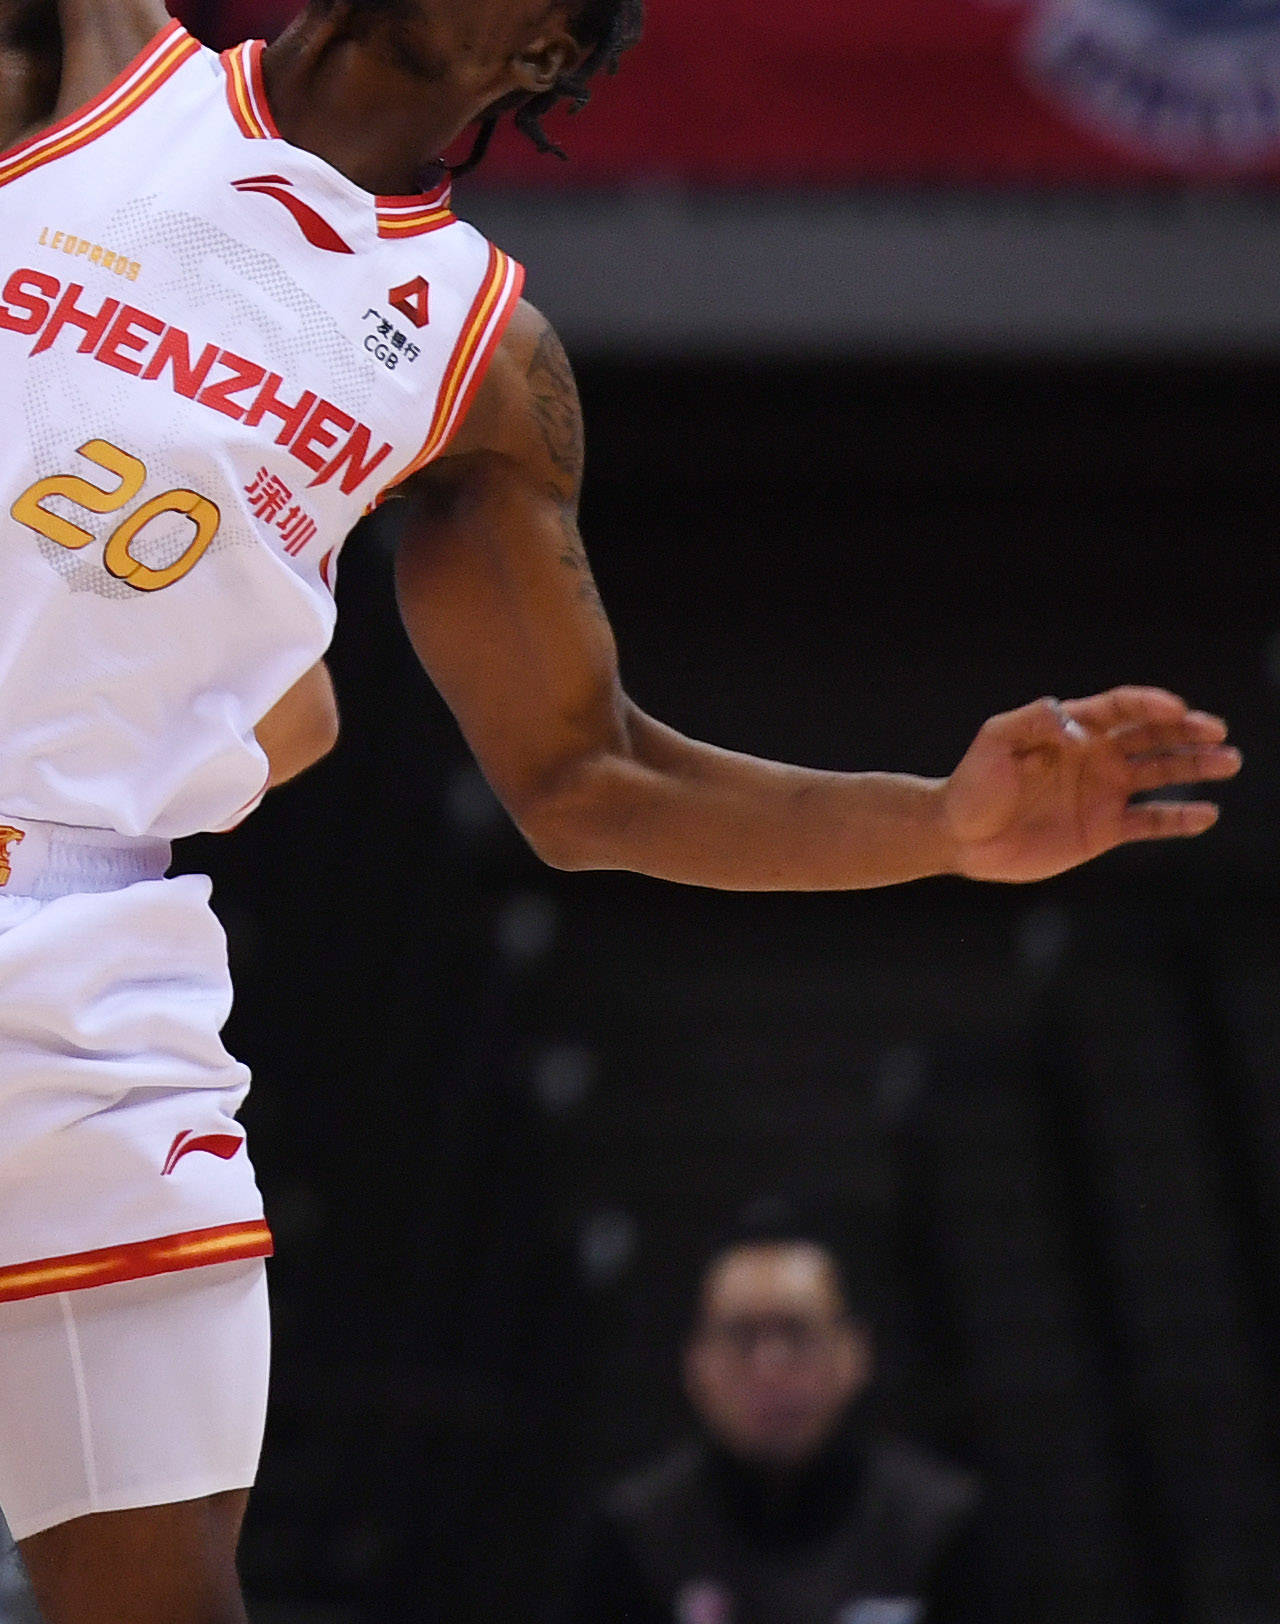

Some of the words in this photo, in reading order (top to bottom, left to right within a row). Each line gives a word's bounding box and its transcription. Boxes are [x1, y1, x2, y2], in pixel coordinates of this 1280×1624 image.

[38, 226, 142, 282] LEOPARDS
[361, 308, 422, 363] 广发银行
[363, 334, 399, 371] CGB
[10, 438, 221, 593] 20
[242, 465, 318, 558] 深圳
